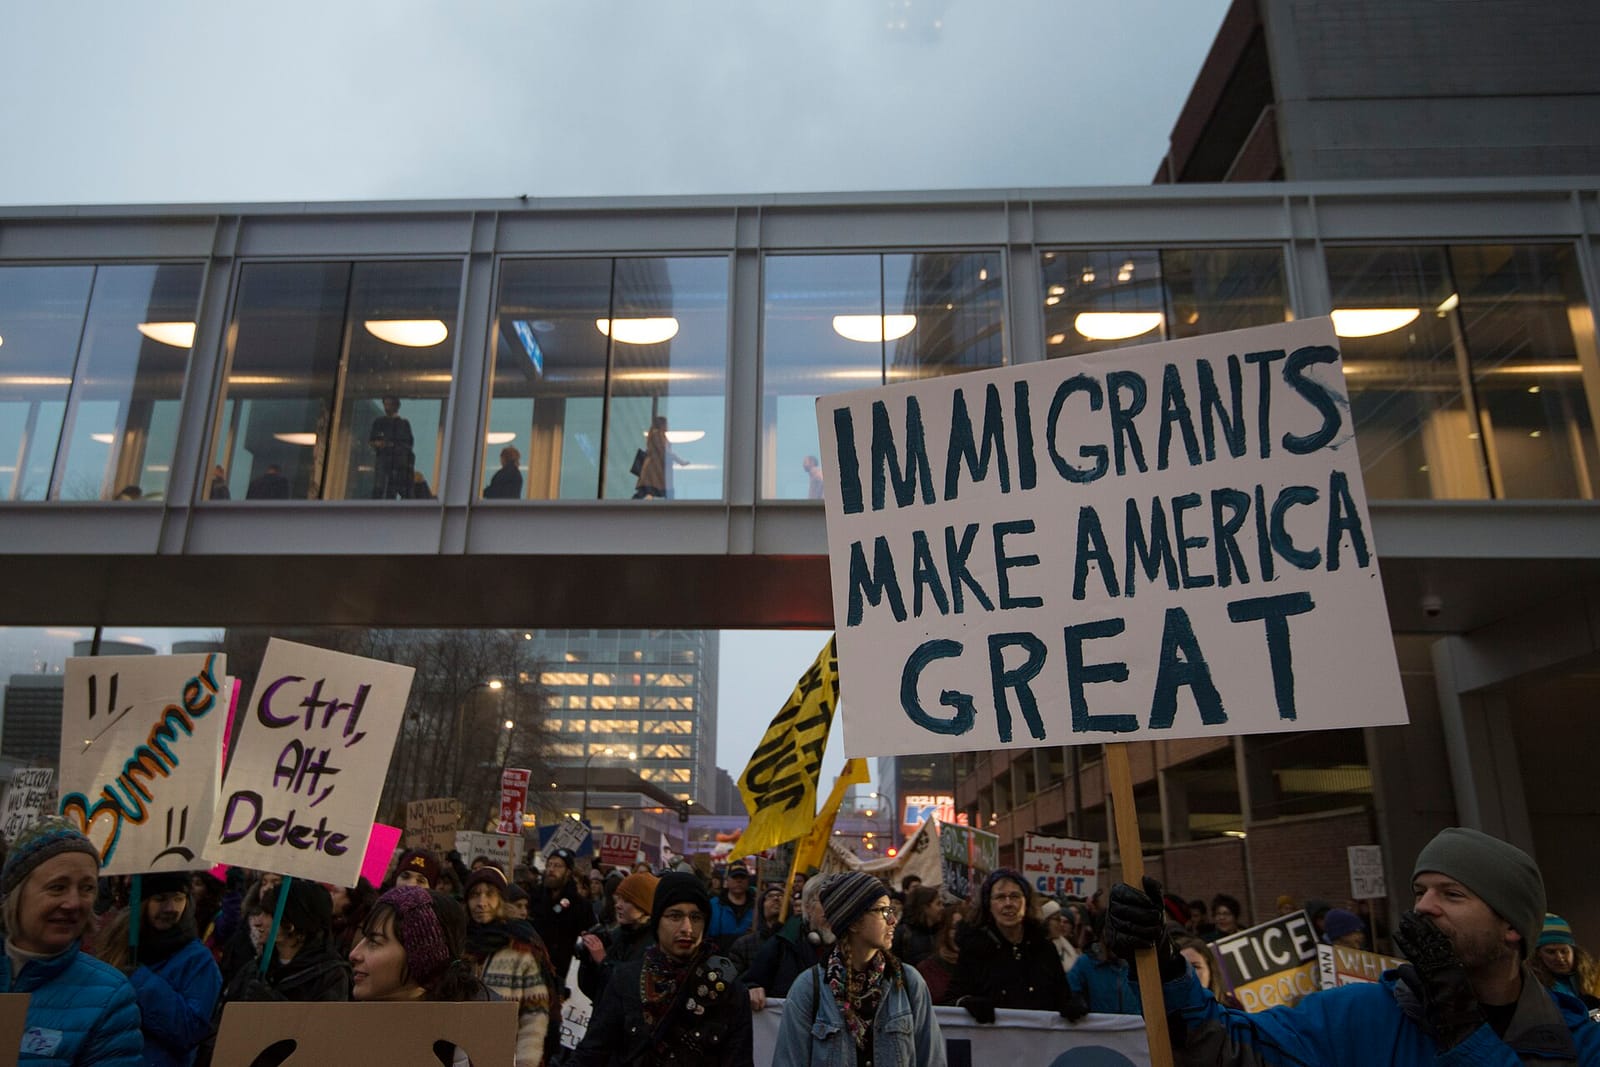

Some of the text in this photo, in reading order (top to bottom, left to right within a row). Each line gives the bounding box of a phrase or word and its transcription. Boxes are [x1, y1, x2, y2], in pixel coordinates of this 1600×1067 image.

[832, 344, 1344, 514] IMMIGRANTS
[846, 469, 1371, 627] MAKE AMERICA
[900, 591, 1316, 742] GREAT
[257, 674, 372, 748] Ctrl,
[59, 652, 220, 868] Bummer
[272, 738, 342, 808] Alt,
[219, 790, 350, 858] Delete
[425, 799, 457, 816] WALLS
[602, 834, 639, 851] LOVE
[1036, 876, 1085, 896] GREAT
[1218, 917, 1316, 981] TICE
